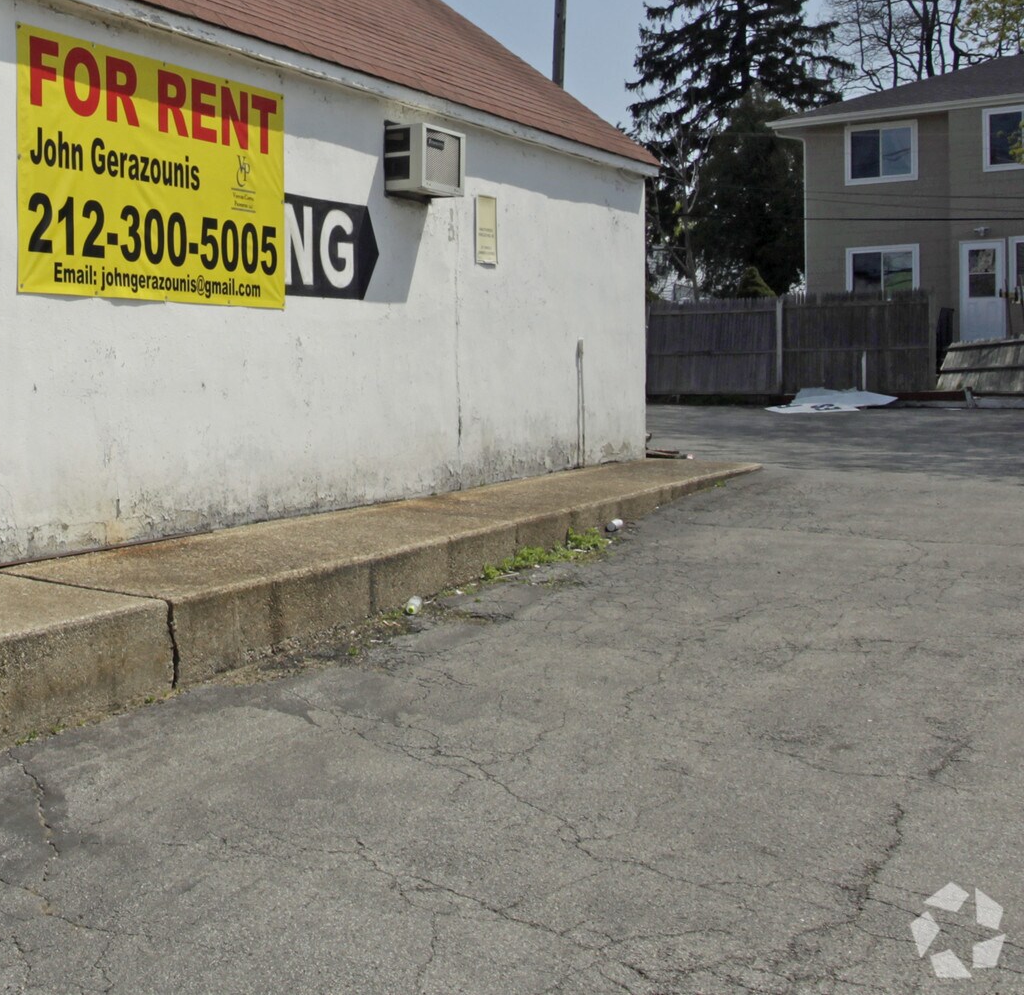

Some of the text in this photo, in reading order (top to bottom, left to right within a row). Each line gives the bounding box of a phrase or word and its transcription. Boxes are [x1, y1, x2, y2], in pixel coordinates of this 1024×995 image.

[29, 36, 278, 155] FOR RENT
[30, 127, 200, 191] John Gerazounis
[28, 192, 278, 276] 212-300-5005
[54, 262, 261, 298] Email: johngerazounis@gmail.com
